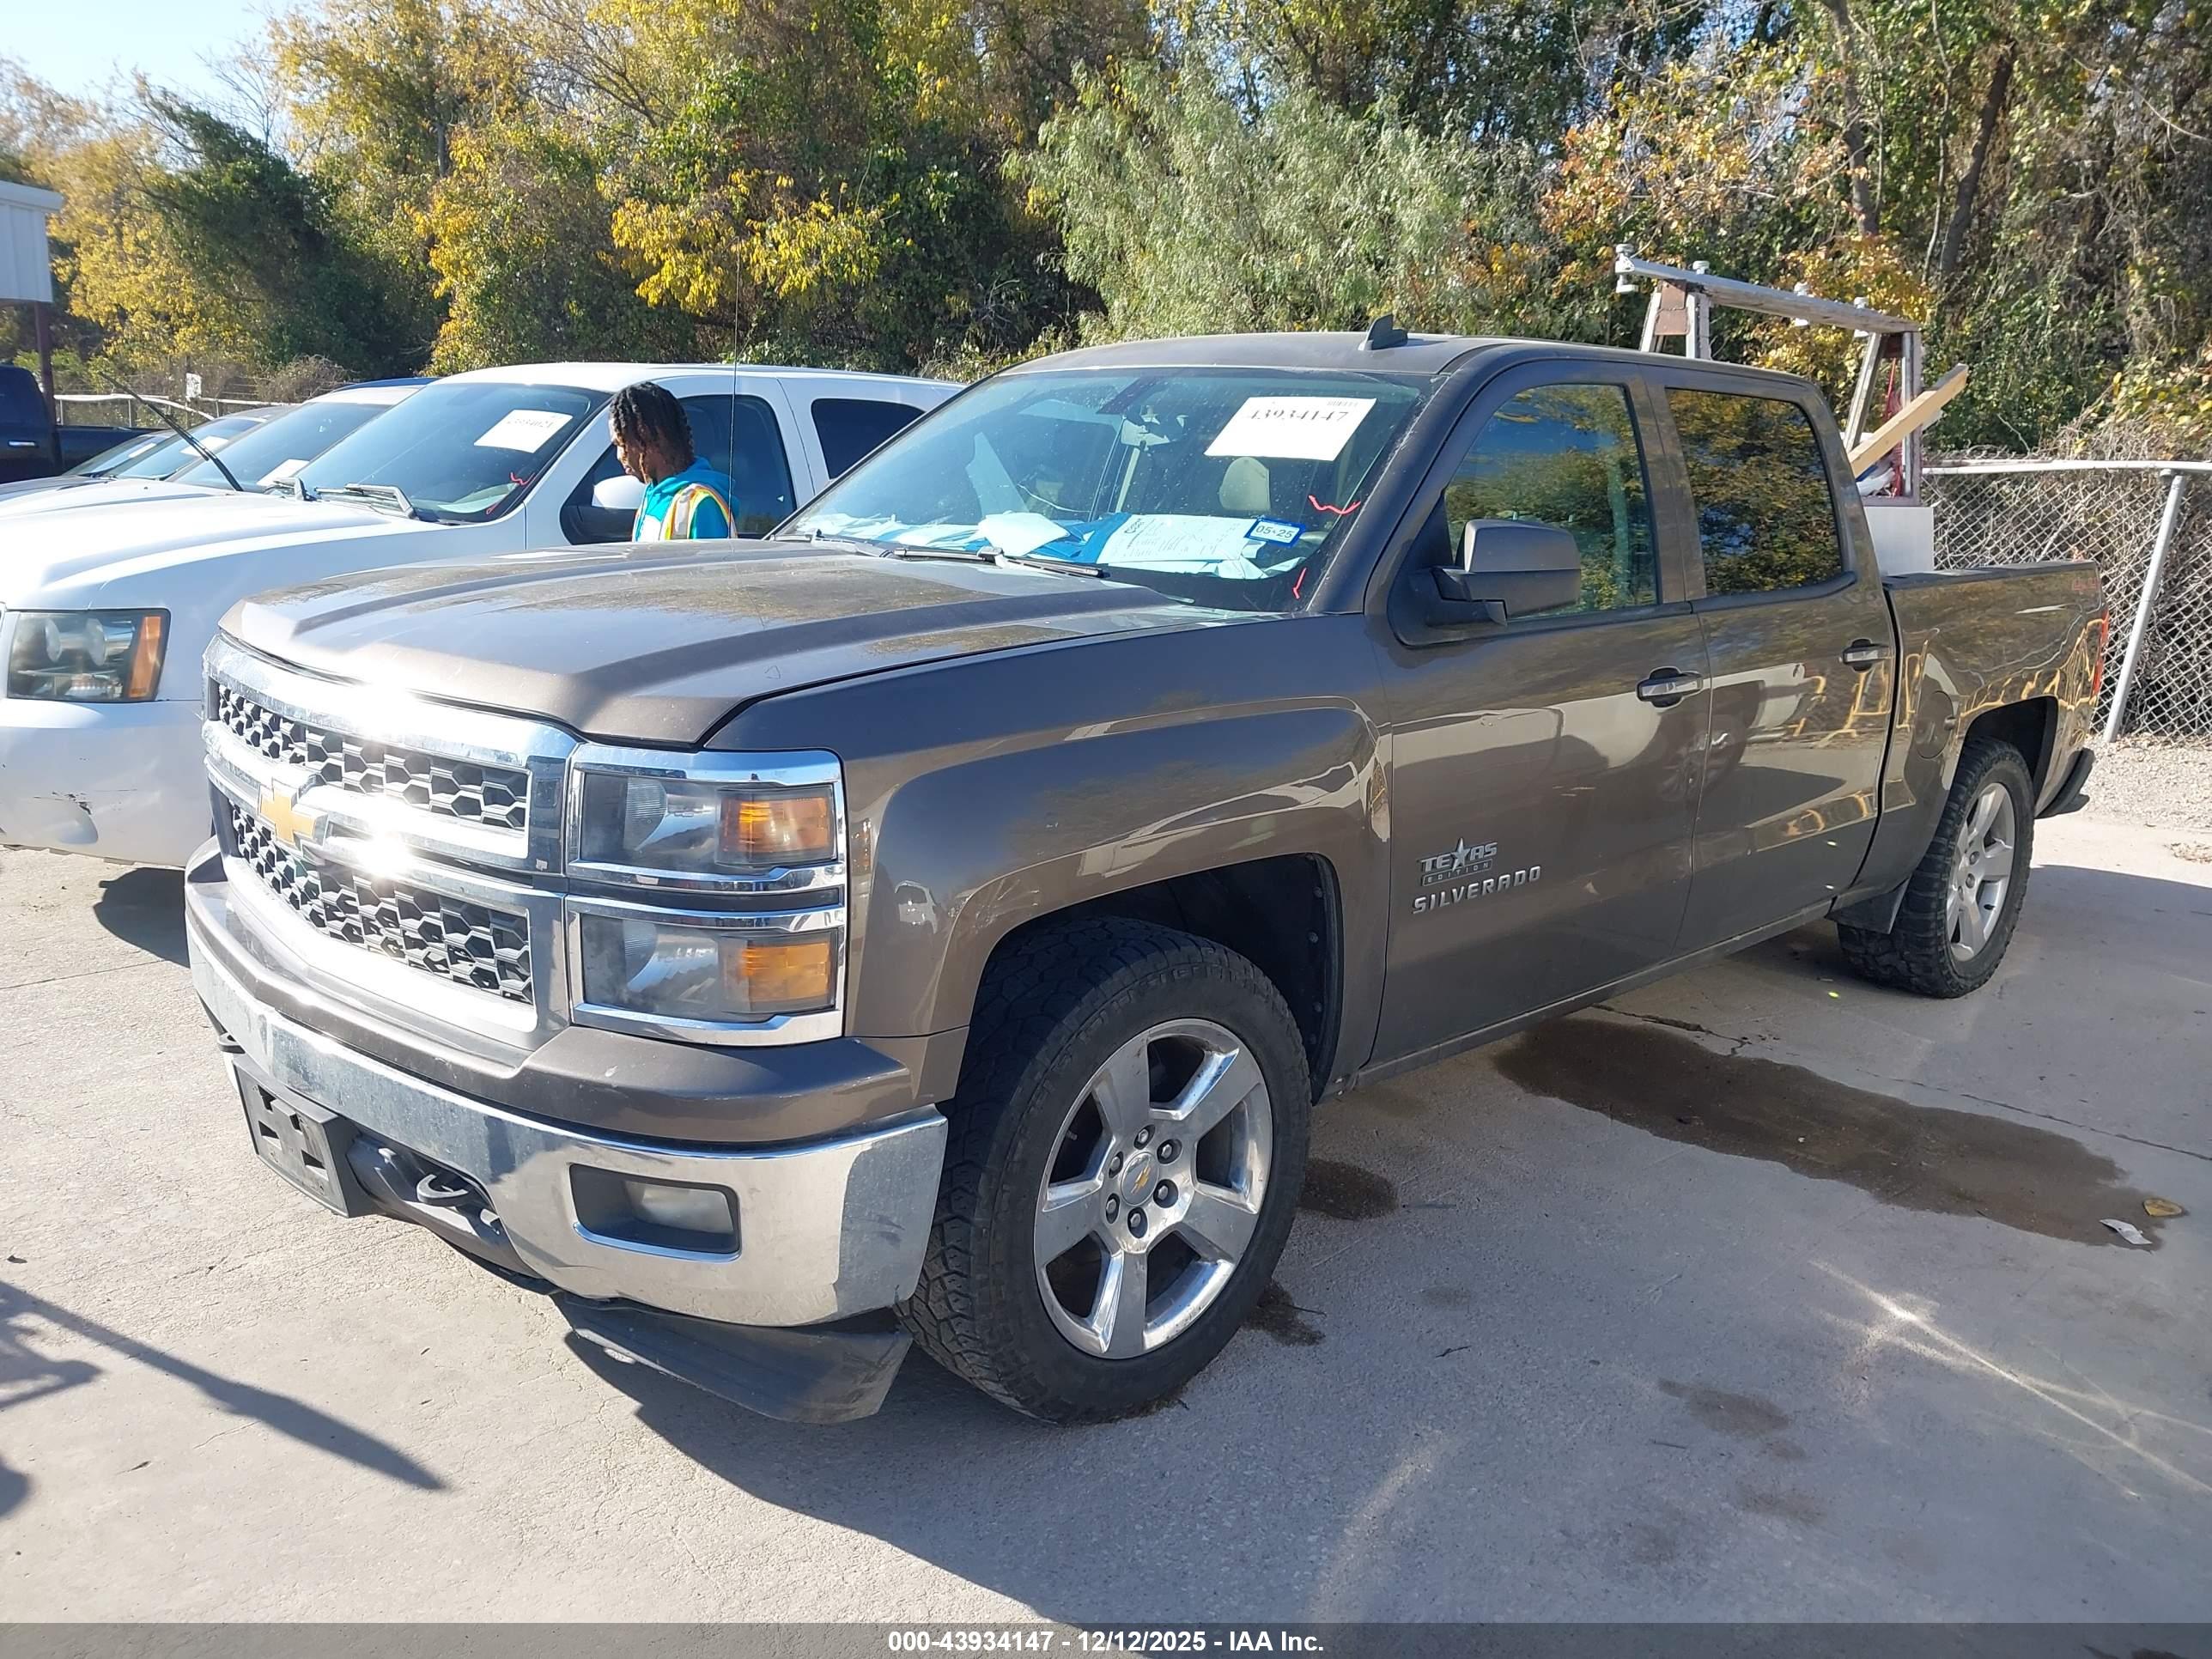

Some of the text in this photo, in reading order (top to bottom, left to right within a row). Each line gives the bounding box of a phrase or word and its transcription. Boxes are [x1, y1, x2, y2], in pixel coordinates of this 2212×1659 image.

[1421, 838, 1498, 872] TEXAS
[1425, 860, 1491, 884] EDITION
[1413, 866, 1541, 915] SILVERADO
